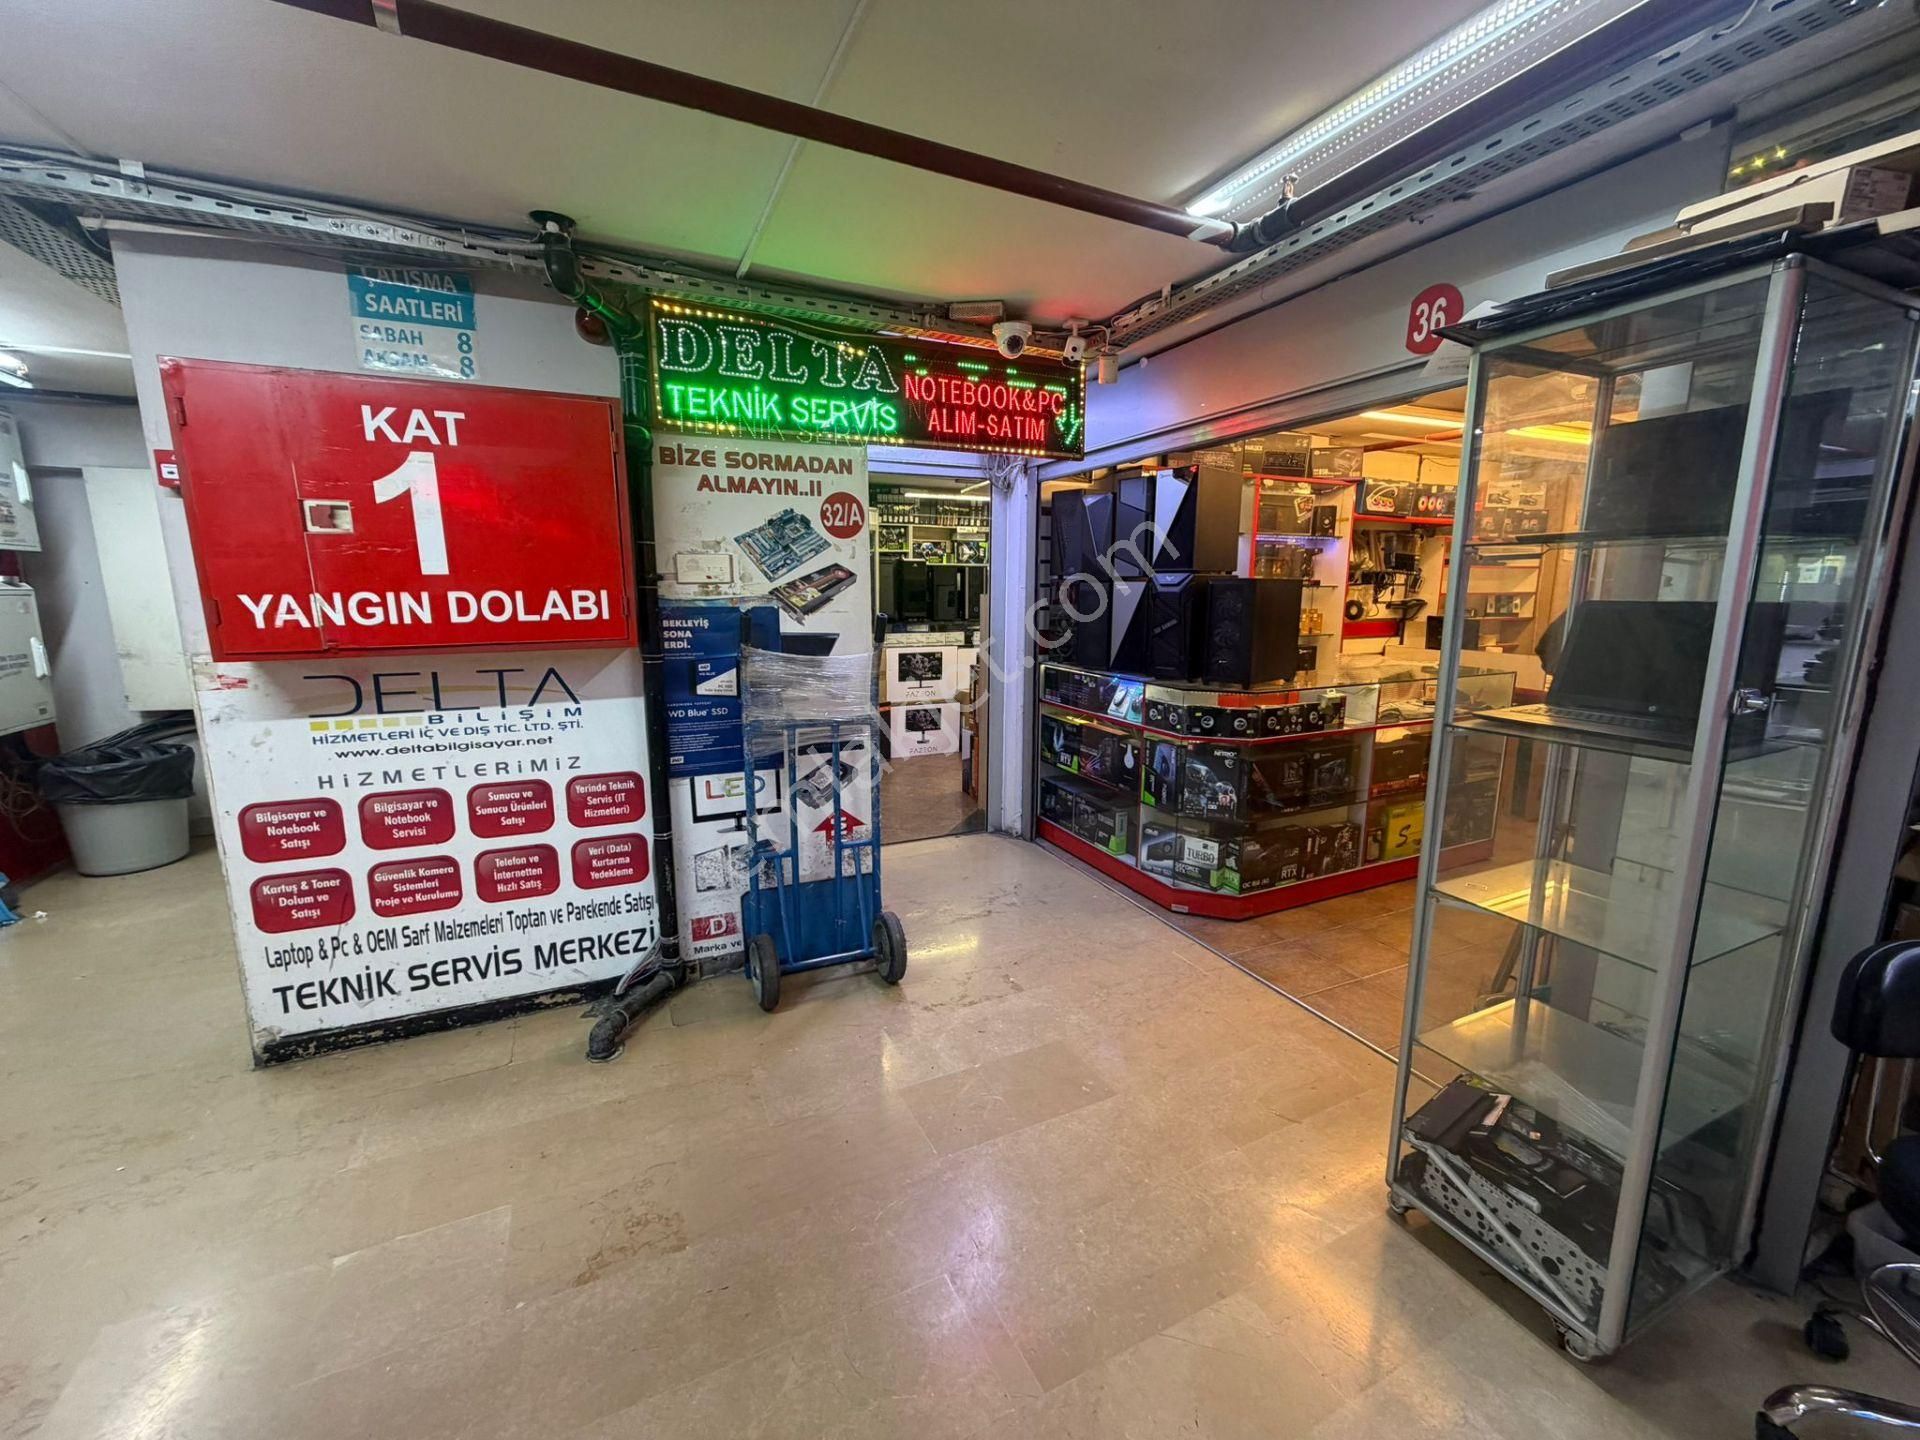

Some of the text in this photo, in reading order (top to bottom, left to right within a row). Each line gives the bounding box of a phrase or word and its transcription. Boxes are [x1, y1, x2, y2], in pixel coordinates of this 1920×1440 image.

[364, 293, 464, 323] SAATLERİ
[1413, 297, 1447, 342] 36
[360, 324, 473, 354] SABAH 8
[658, 318, 899, 393] DELTA
[904, 374, 1065, 415] NOTEBOOK&PC
[667, 384, 898, 431] TEKNİK SERVİS
[360, 404, 466, 446] KAT
[927, 408, 1045, 441] ALIM-SATIM
[659, 443, 853, 475] BİZE SORMADAN
[373, 451, 449, 575] 1
[823, 502, 863, 527] 32/A
[237, 589, 610, 629] YANGIN DOLABI
[662, 617, 710, 629] BEKLEYİŞ
[663, 630, 693, 639] SONA
[664, 639, 691, 649] ERDİ.
[303, 667, 581, 718] DELTA
[668, 710, 686, 718] WD
[711, 707, 729, 716] SSD
[312, 728, 415, 745] HİZMETLERİ
[438, 728, 460, 737] VE
[464, 725, 490, 736] DIŞ
[494, 722, 521, 733] TİC.
[525, 722, 554, 732] LTD.
[558, 719, 583, 731] ŞTİ.
[335, 736, 553, 759] www.deltabilgisayar.net
[575, 780, 635, 794] Yerinde Teknik
[488, 790, 533, 801] Sunucu ve
[587, 795, 613, 805] Servis
[374, 800, 438, 813] Bilgisayar ve
[476, 800, 547, 816] Sunucu Ürünleri
[584, 805, 630, 818] Hizmetleri)
[256, 809, 327, 824] Bilgisayar ve
[384, 813, 431, 826] Notebook
[501, 816, 526, 827] Satışı
[267, 822, 320, 836] Notebook
[392, 826, 427, 839] Servisi
[280, 839, 311, 850] Satışı
[588, 842, 632, 856] Veri (Data)
[495, 855, 540, 868] Telefon ve
[592, 856, 630, 868] Kurtarma
[1187, 847, 1215, 864] TURBO
[374, 866, 454, 882] Güvenlik Kamera
[590, 867, 634, 880] Yedekleme
[262, 879, 341, 895] Kartuş & Toner
[393, 880, 439, 892] Sistemleri
[497, 879, 542, 893] Hızlı Satış
[279, 894, 330, 907] Dolum ve
[375, 890, 460, 907] Proje ve Kurulumu
[291, 909, 321, 919] Satışı
[265, 893, 655, 972] Laptop & Pc & OEM Sarf Malzemeleri Toptan ve Parekende Satışı
[694, 943, 728, 955] Marka
[272, 920, 656, 1014] TEKNİK SERVİS MERKEZİ
